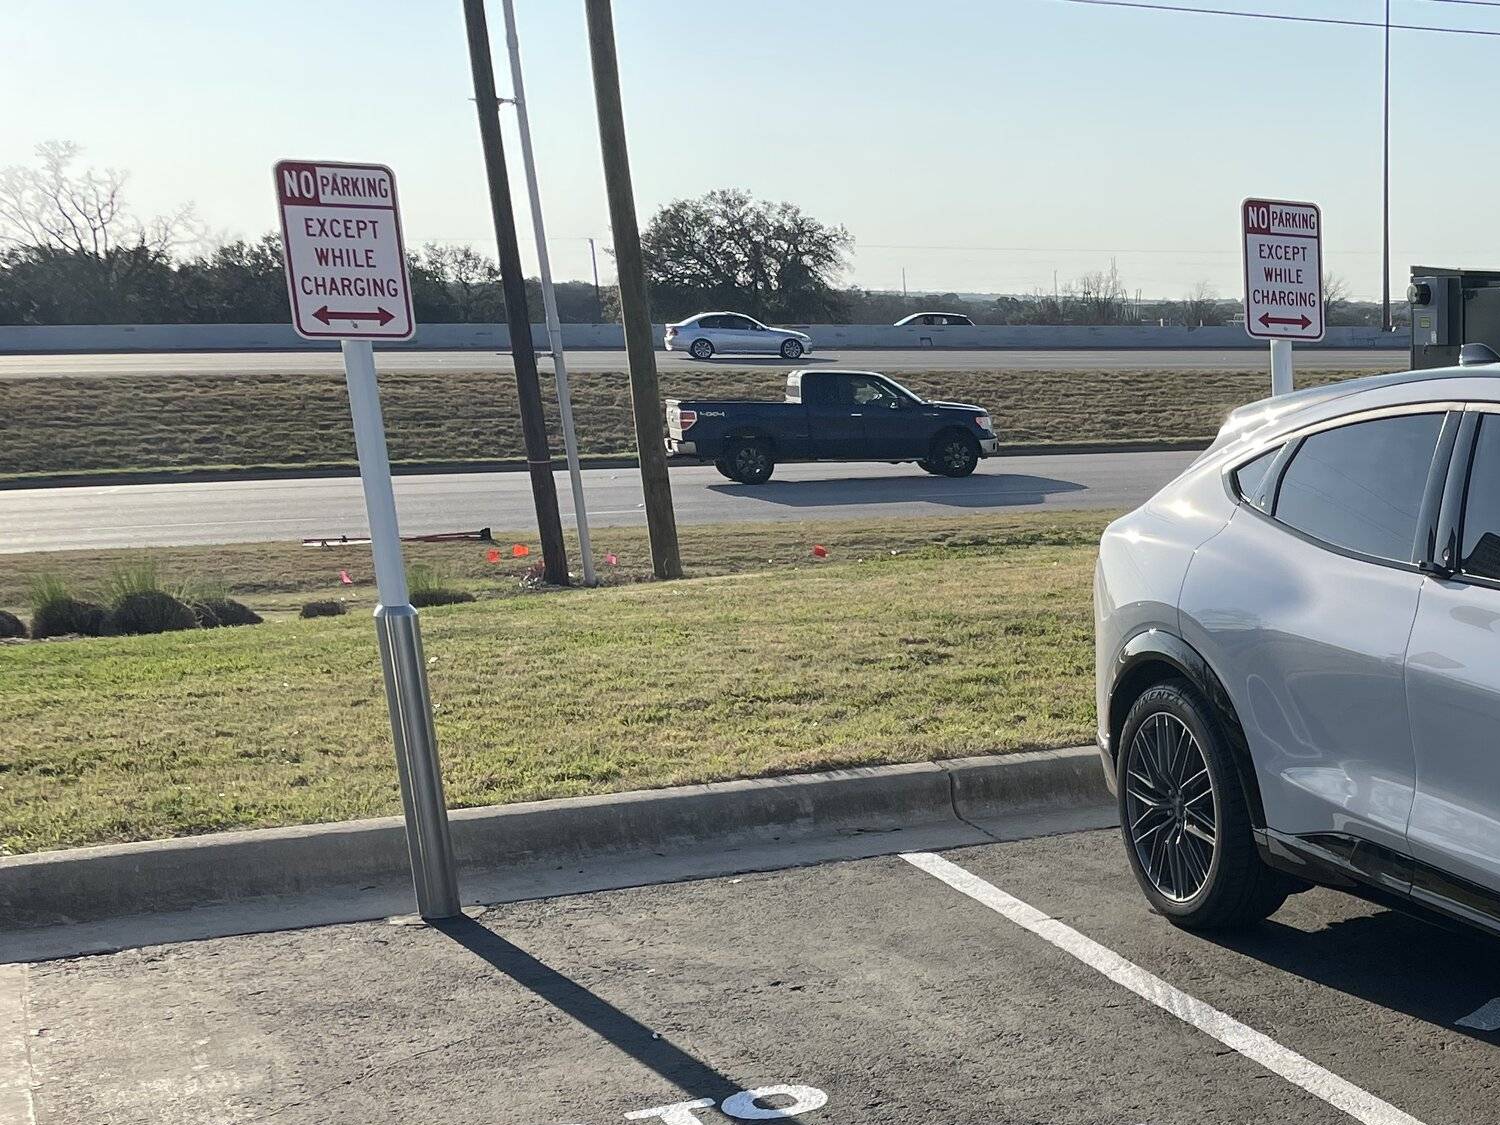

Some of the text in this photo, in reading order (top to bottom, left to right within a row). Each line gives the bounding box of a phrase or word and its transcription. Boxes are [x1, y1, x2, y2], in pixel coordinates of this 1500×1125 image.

[283, 169, 388, 199] NO PARKING
[304, 217, 379, 240] EXCEPT
[1248, 206, 1316, 230] NO PARKING
[314, 247, 377, 268] WHILE
[1258, 243, 1308, 262] EXCEPT
[1263, 266, 1304, 285] WHILE
[301, 276, 398, 298] CHARGING
[1252, 289, 1316, 308] CHARGING
